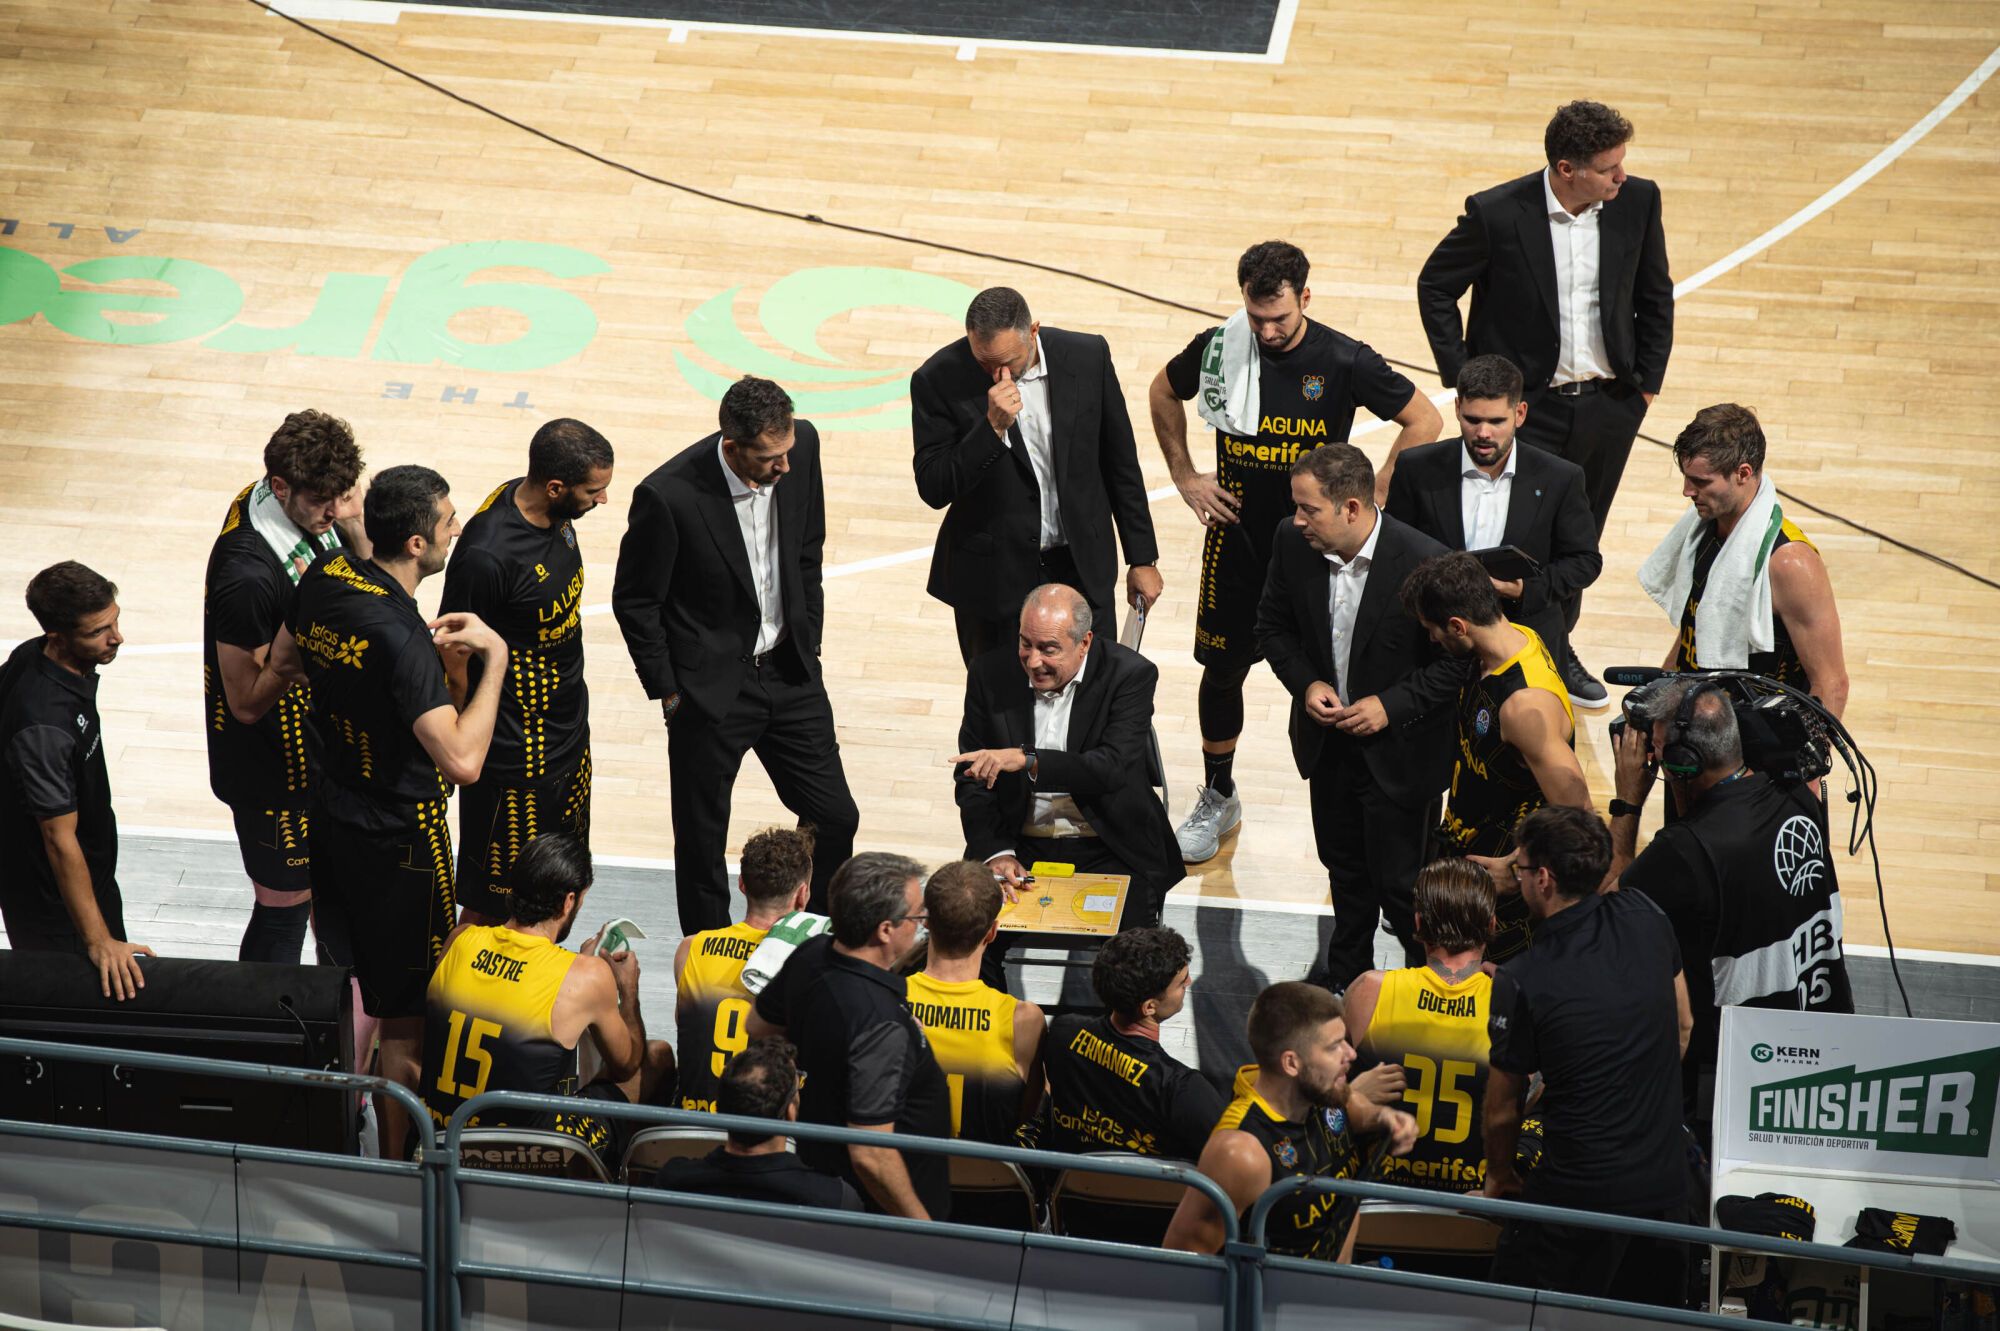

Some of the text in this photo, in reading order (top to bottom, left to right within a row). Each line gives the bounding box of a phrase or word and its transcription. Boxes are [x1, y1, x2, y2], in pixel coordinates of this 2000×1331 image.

[381, 381, 535, 409] THE
[1258, 415, 1327, 436] AGUNA
[295, 627, 336, 660] anarias
[310, 621, 339, 646] Islas
[701, 937, 760, 960] MARCE
[471, 949, 528, 983] SASTRE
[907, 1001, 991, 1032] ROMAITIS
[1417, 988, 1476, 1018] GUERRA
[711, 998, 752, 1078] 9
[1777, 1046, 1820, 1058] KERN
[437, 1009, 503, 1099] 15
[1069, 1028, 1149, 1087] FERNÁNDEZ
[1403, 1053, 1476, 1144] 35
[1758, 1071, 1976, 1136] FINISHER
[1053, 1106, 1125, 1146] Canarias
[1082, 1104, 1124, 1134] Islas
[1748, 1132, 1869, 1150] SALUD Y NUTRICIÓN DEPORTIVA
[459, 1146, 577, 1169] nerife!
